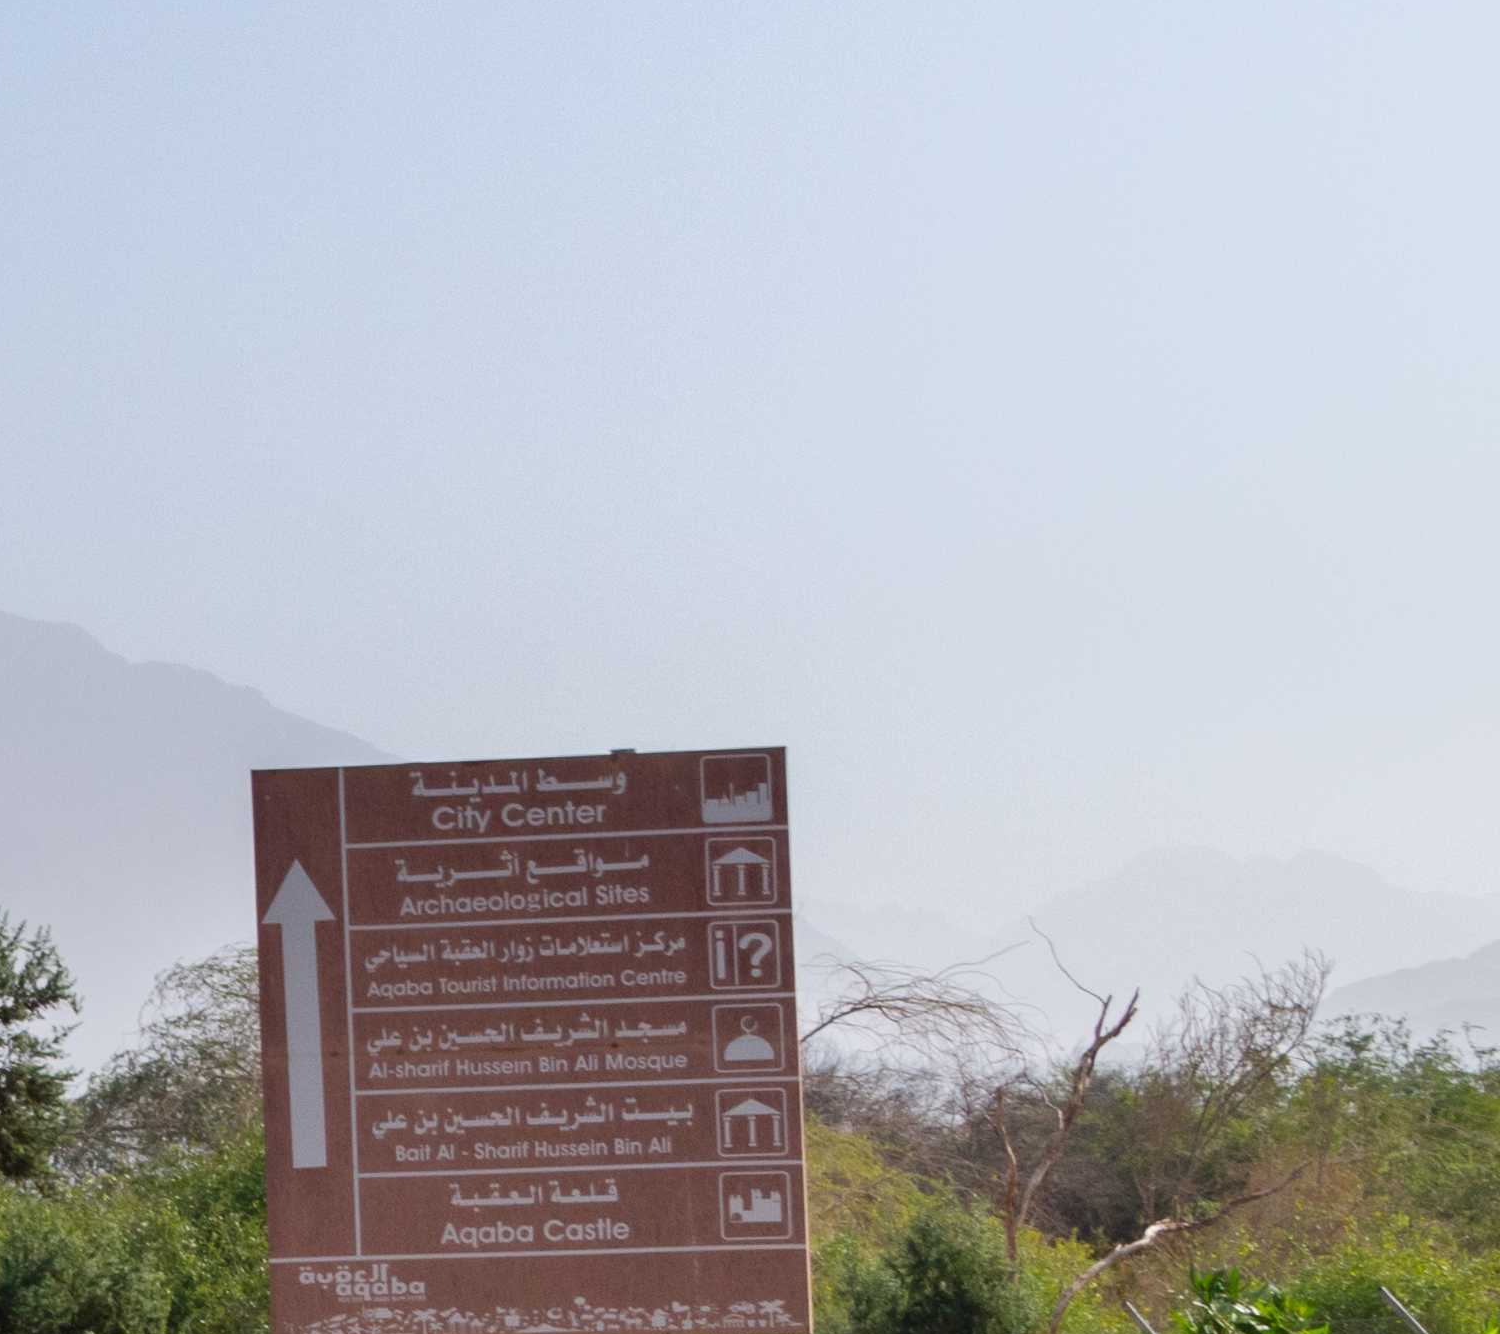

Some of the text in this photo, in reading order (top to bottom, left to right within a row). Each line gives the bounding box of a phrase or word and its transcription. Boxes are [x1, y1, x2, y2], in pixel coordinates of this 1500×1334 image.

[409, 768, 627, 803] وسط المدينة
[431, 800, 607, 833] City Center
[526, 848, 650, 884] مواقع
[400, 884, 650, 916] Archaeological Sites
[364, 931, 686, 974] مركز استعلامات زوار العقبة السياحي
[367, 968, 687, 999] Aqaba Tourist Information Centre
[366, 1012, 688, 1057] مسجد الشريف الحسين بن علي
[368, 1053, 689, 1079] Al-sharif Hussein Bin Ali Mosque
[371, 1095, 694, 1140] بيت الشريف الحسين بن علي
[395, 1144, 432, 1162] Bait
[436, 1143, 455, 1161] Al
[473, 1140, 531, 1160] Sharif
[534, 1138, 608, 1158] Hussein
[613, 1136, 643, 1156] Bin
[647, 1136, 672, 1154] Ali
[448, 1177, 620, 1213] قلعة العقبة
[440, 1218, 631, 1249] Aqaba Castle
[299, 1263, 389, 1289] العقبة
[335, 1275, 426, 1301] aqaba
